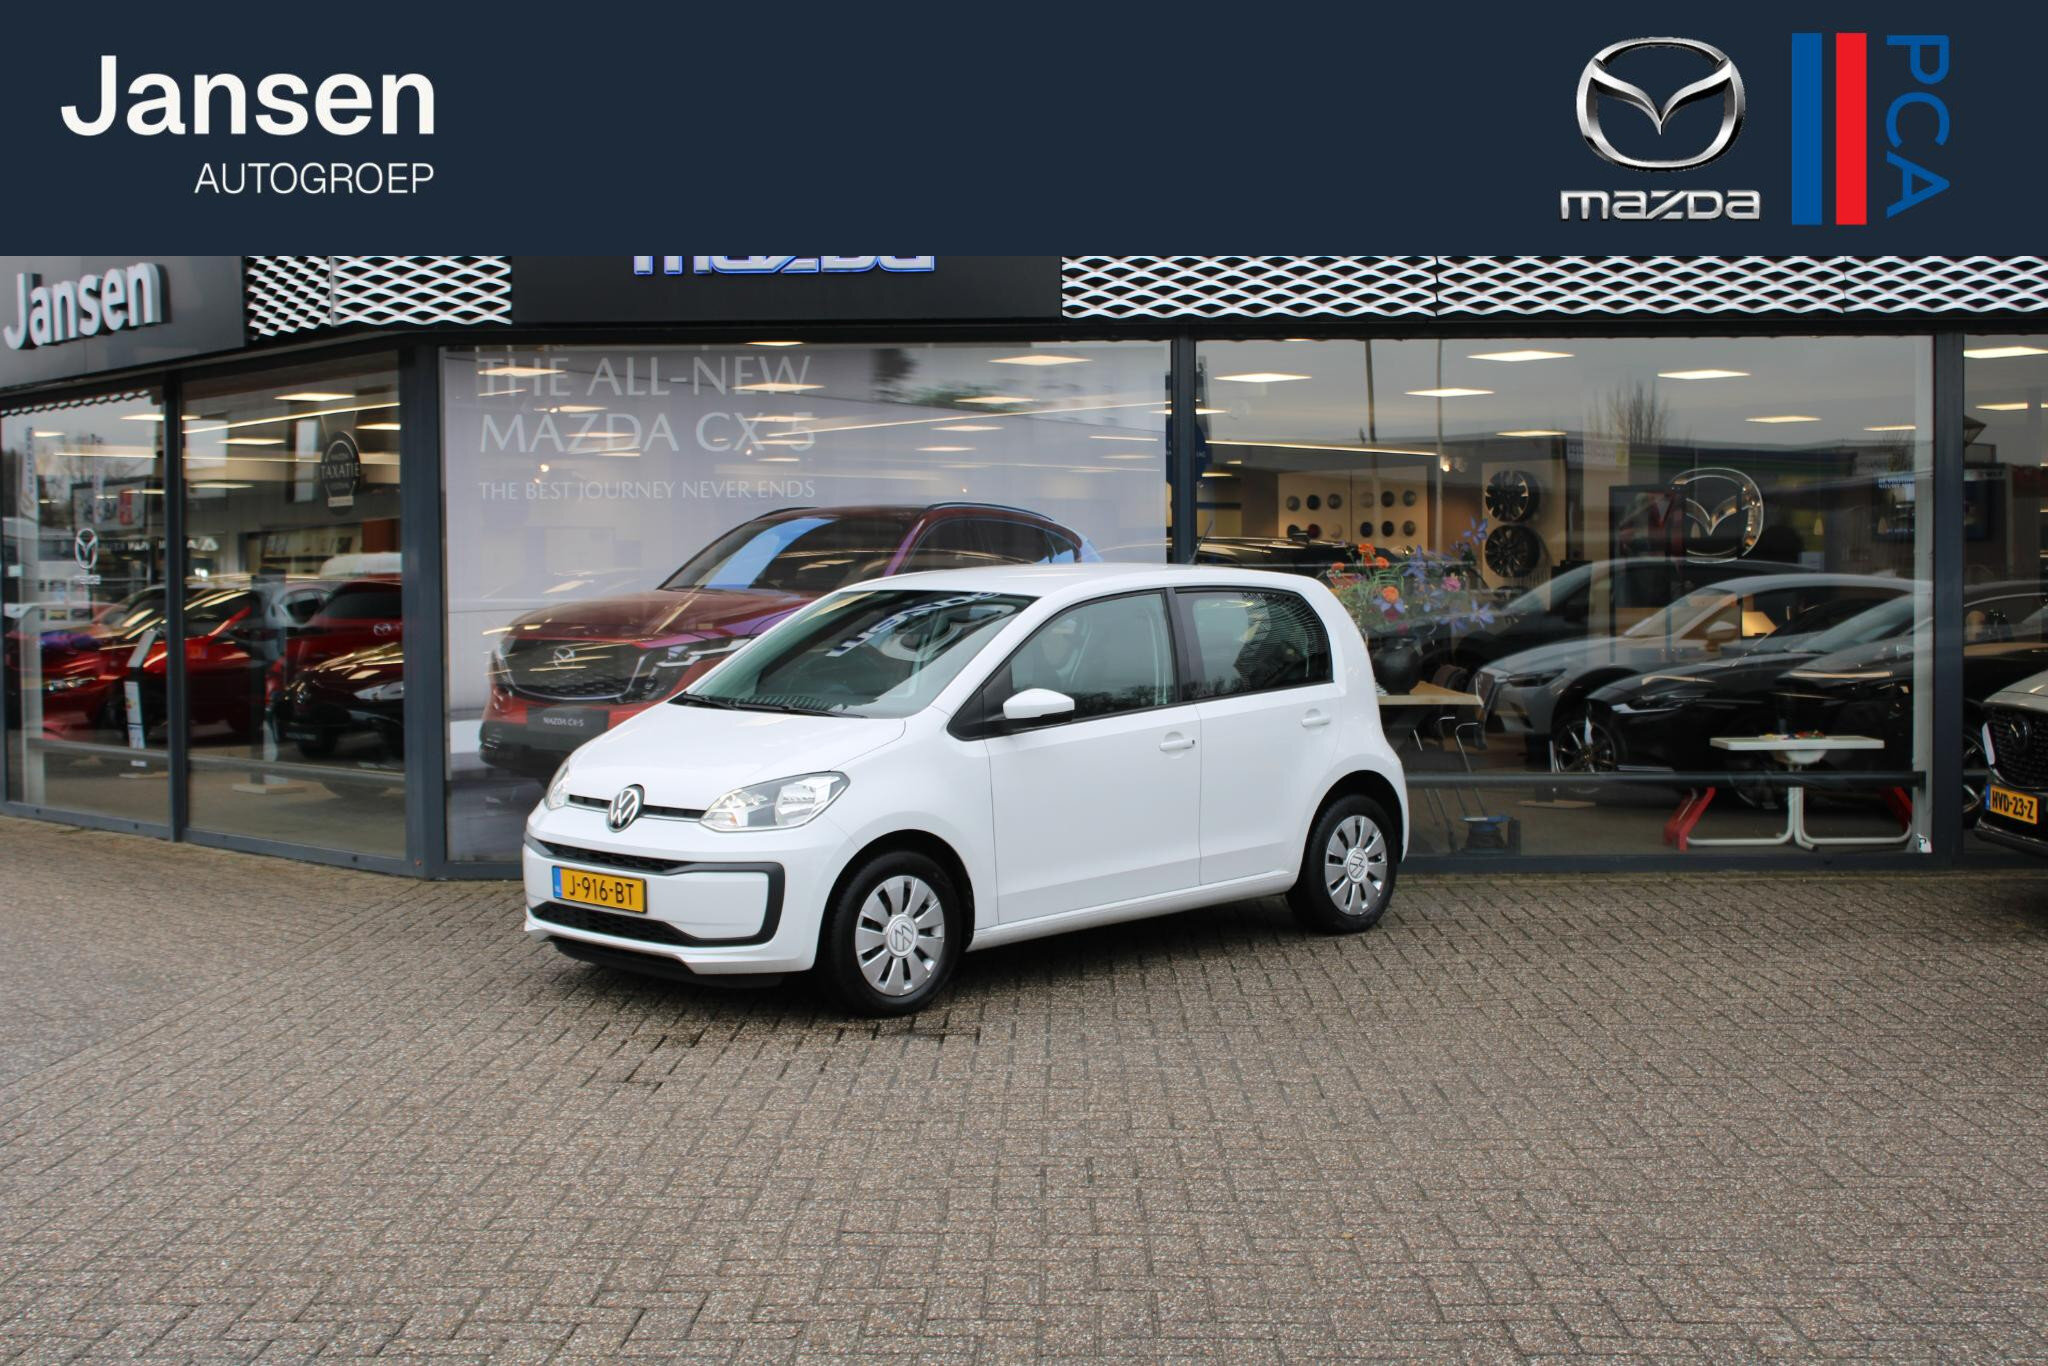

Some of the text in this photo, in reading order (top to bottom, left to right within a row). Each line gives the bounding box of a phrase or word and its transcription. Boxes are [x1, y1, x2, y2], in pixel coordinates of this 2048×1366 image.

[3, 262, 166, 350] Jansen
[477, 357, 811, 396] THE ALL-NEW
[479, 413, 680, 453] MAZDA
[478, 481, 816, 500] THE BEST JOURNEY NEVER ENDS
[569, 875, 634, 905] J-916-BT
